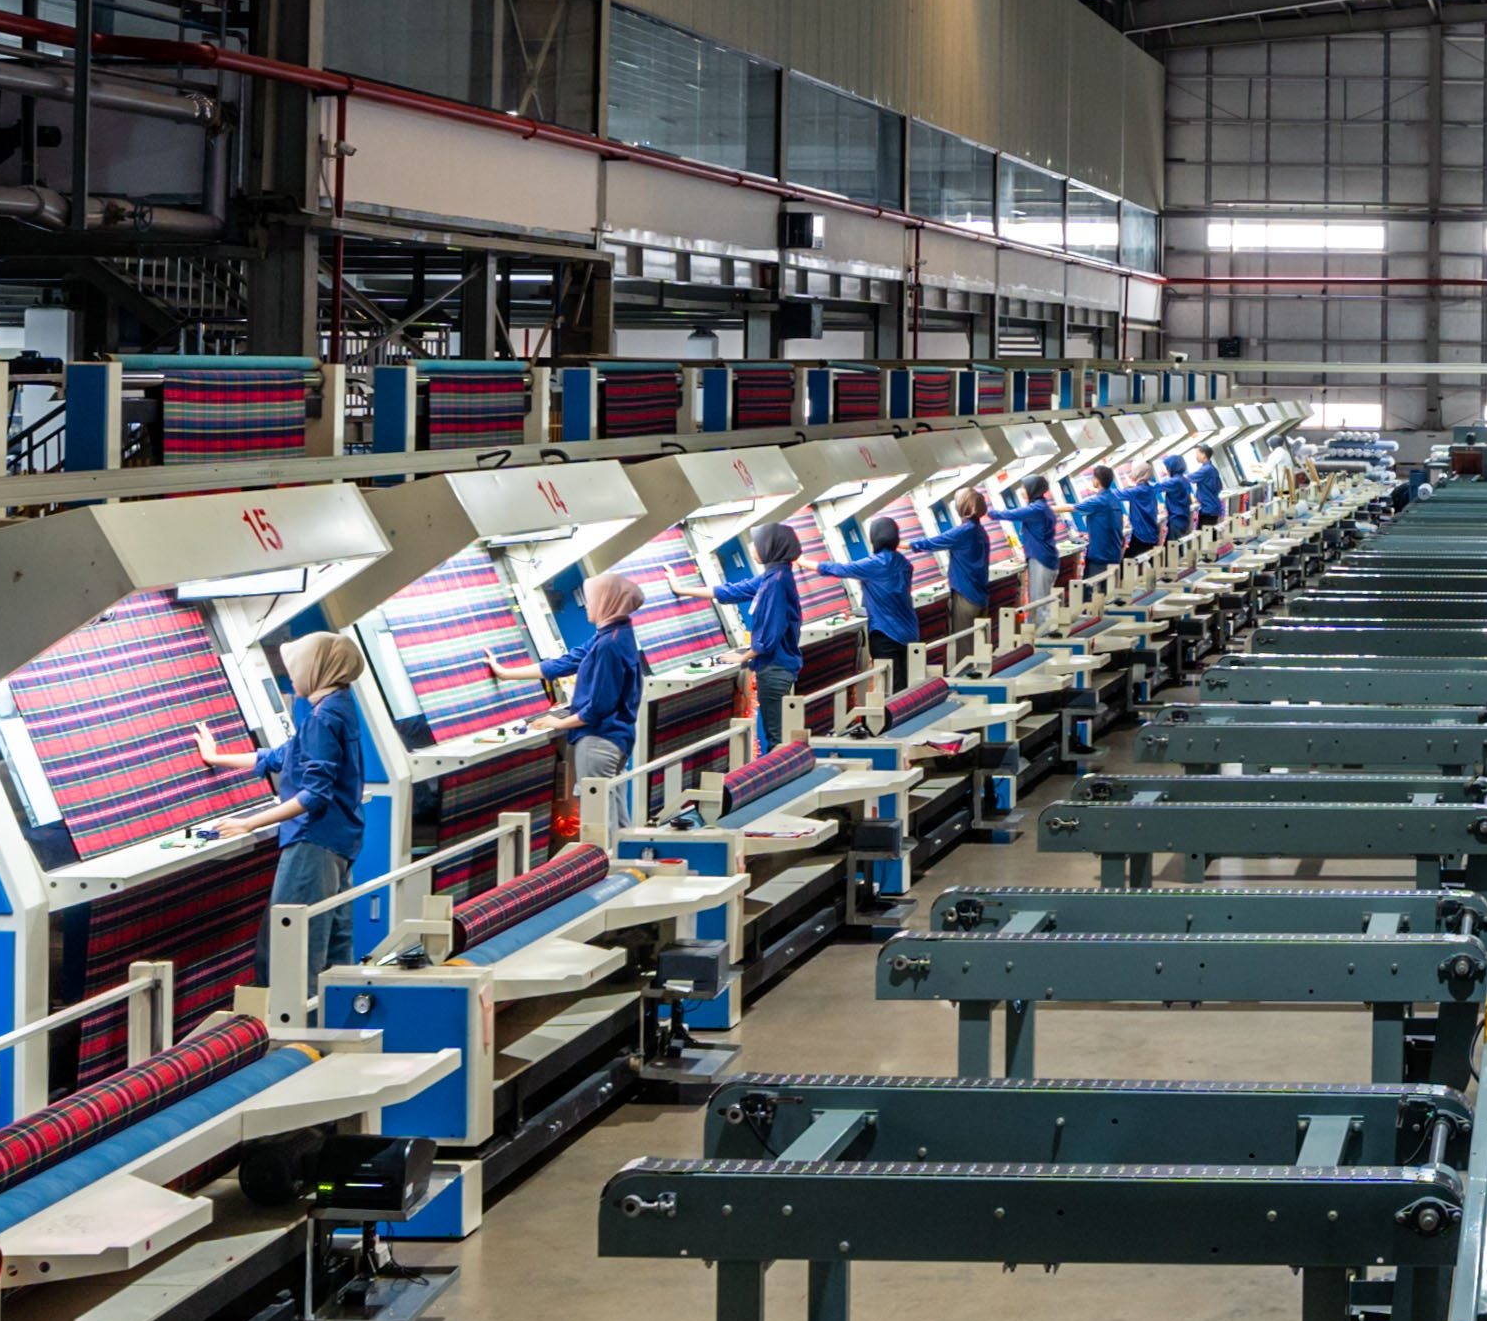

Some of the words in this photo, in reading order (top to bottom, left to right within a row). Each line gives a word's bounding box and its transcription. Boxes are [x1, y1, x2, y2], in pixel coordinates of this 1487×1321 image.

[732, 458, 754, 487] 13
[537, 478, 569, 515] 14
[242, 508, 284, 552] 15
